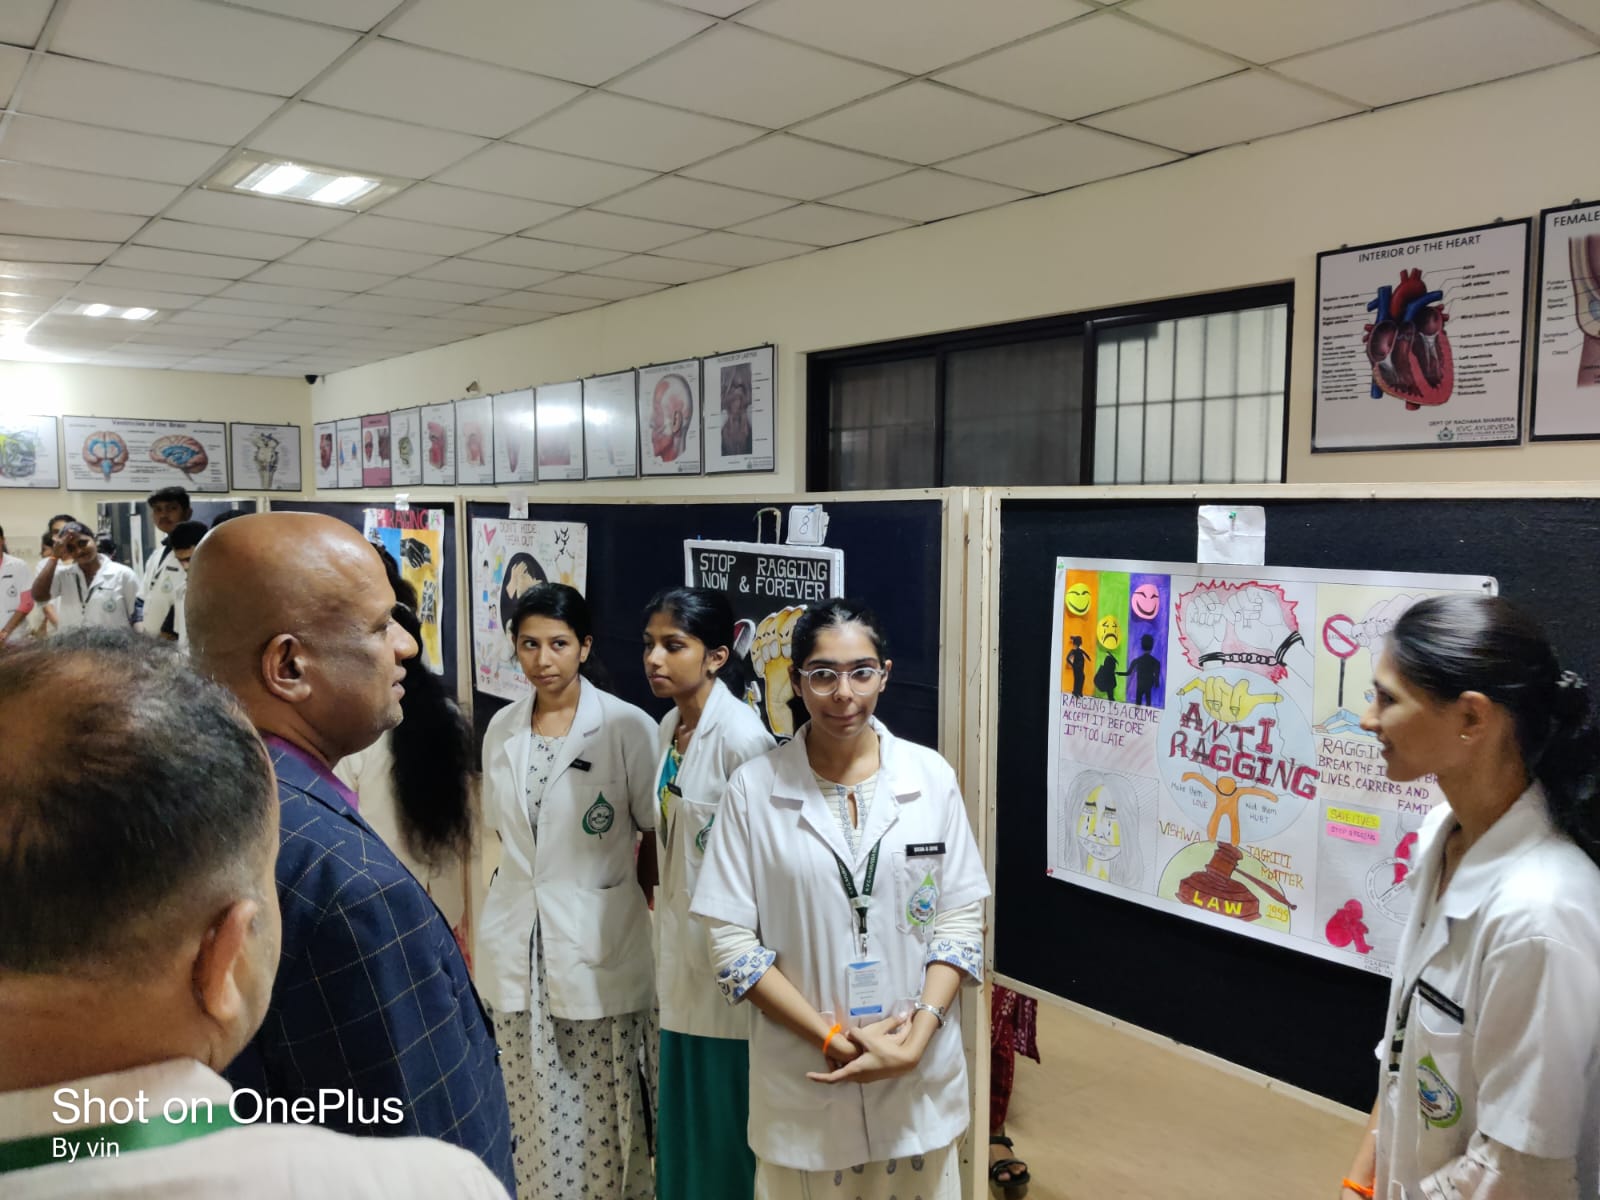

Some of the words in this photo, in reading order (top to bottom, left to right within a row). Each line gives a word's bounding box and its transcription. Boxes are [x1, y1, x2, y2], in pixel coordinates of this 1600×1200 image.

[1553, 210, 1600, 227] FEMALE
[1359, 247, 1404, 263] INTERIOR
[1407, 244, 1420, 255] OF
[1423, 241, 1443, 252] THE
[1446, 234, 1481, 249] HEART
[799, 515, 810, 535] 8
[700, 552, 737, 573] STOP
[756, 557, 828, 581] RAGGING
[702, 572, 729, 591] NOW
[738, 575, 750, 593] &
[755, 576, 825, 601] FOREVER
[1062, 693, 1106, 713] RAGGING
[1108, 701, 1119, 716] IS
[1120, 705, 1128, 718] A
[1129, 706, 1160, 723] CRIME
[1063, 710, 1090, 722] ACCEPT
[1091, 713, 1107, 727] IT
[1108, 717, 1144, 735] BEFORE
[1180, 702, 1276, 755] ANTI
[1083, 726, 1099, 741] TOO
[1101, 731, 1125, 747] LATE
[1322, 737, 1381, 759] RAGGI
[1168, 730, 1321, 800] RAGGING
[1317, 754, 1353, 772] BREAK
[1355, 761, 1373, 775] THE
[1405, 786, 1430, 800] AND
[1158, 819, 1202, 843] VISHWA
[1193, 890, 1243, 916] LAW
